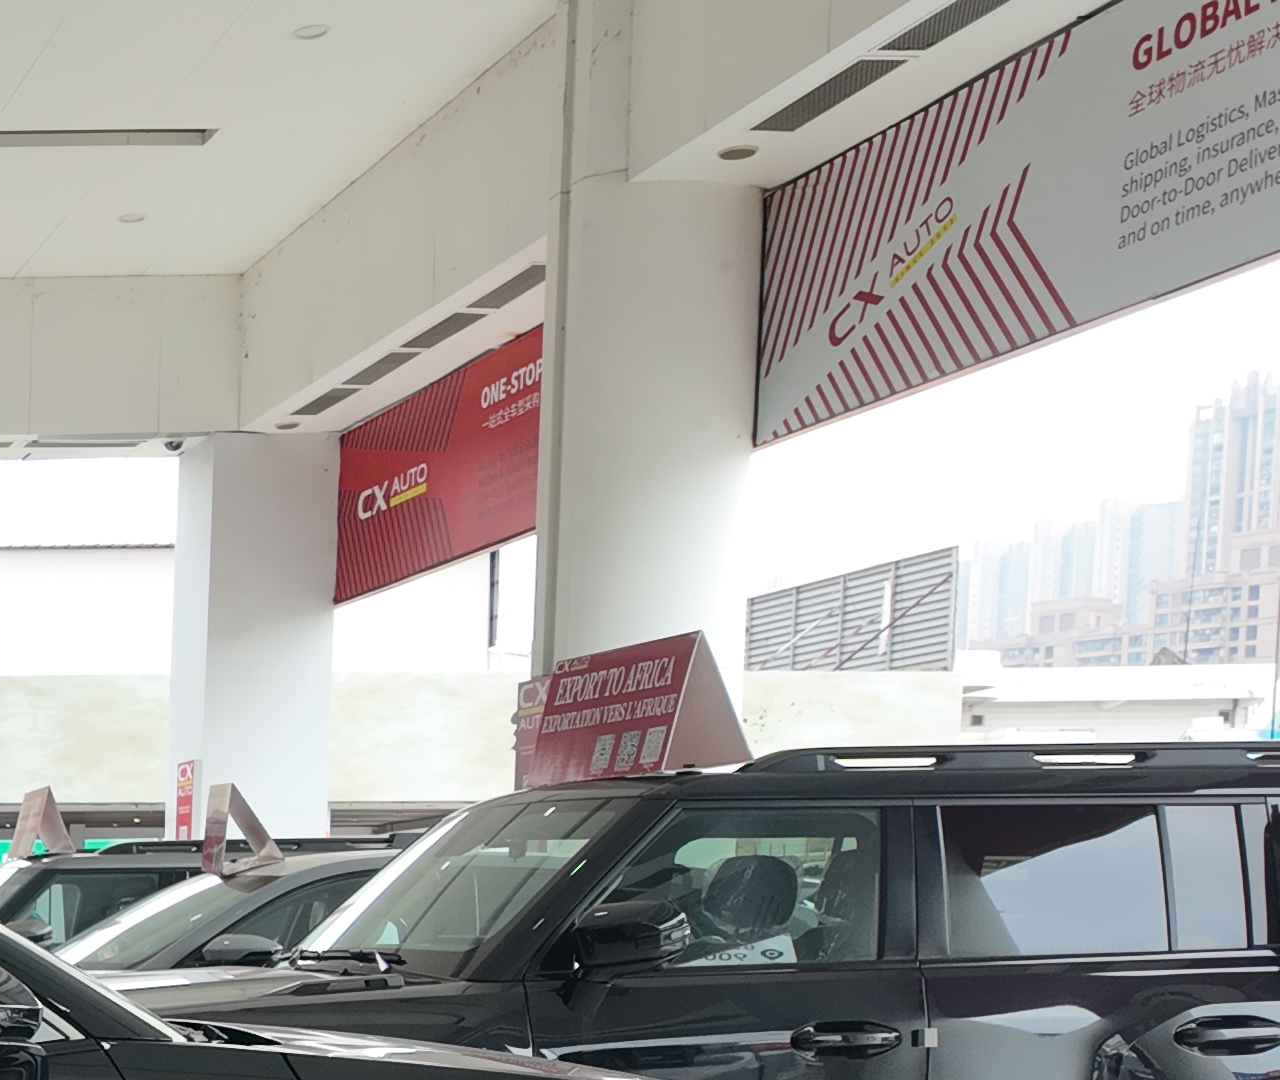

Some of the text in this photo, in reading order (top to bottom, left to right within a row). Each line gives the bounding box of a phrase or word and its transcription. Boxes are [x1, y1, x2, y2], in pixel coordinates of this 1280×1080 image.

[1121, 119, 1279, 198] shipping, insurance,
[1123, 133, 1173, 171] Global
[1177, 104, 1249, 144] Logistics,
[1120, 167, 1224, 224] Door-to-Door
[1118, 221, 1147, 250] and
[1150, 216, 1170, 237] on
[1174, 199, 1215, 226] time,
[828, 196, 954, 347] CX AUTO
[357, 479, 389, 520] CX
[390, 463, 428, 496] AUTO
[553, 655, 675, 706] EXPORT TO AFRICA
[554, 660, 572, 674] CX
[519, 680, 551, 708] CX
[541, 693, 678, 734] EXPORTATION VERS L'AFRIQUE
[518, 714, 542, 731] AUT
[178, 763, 193, 781] CX
